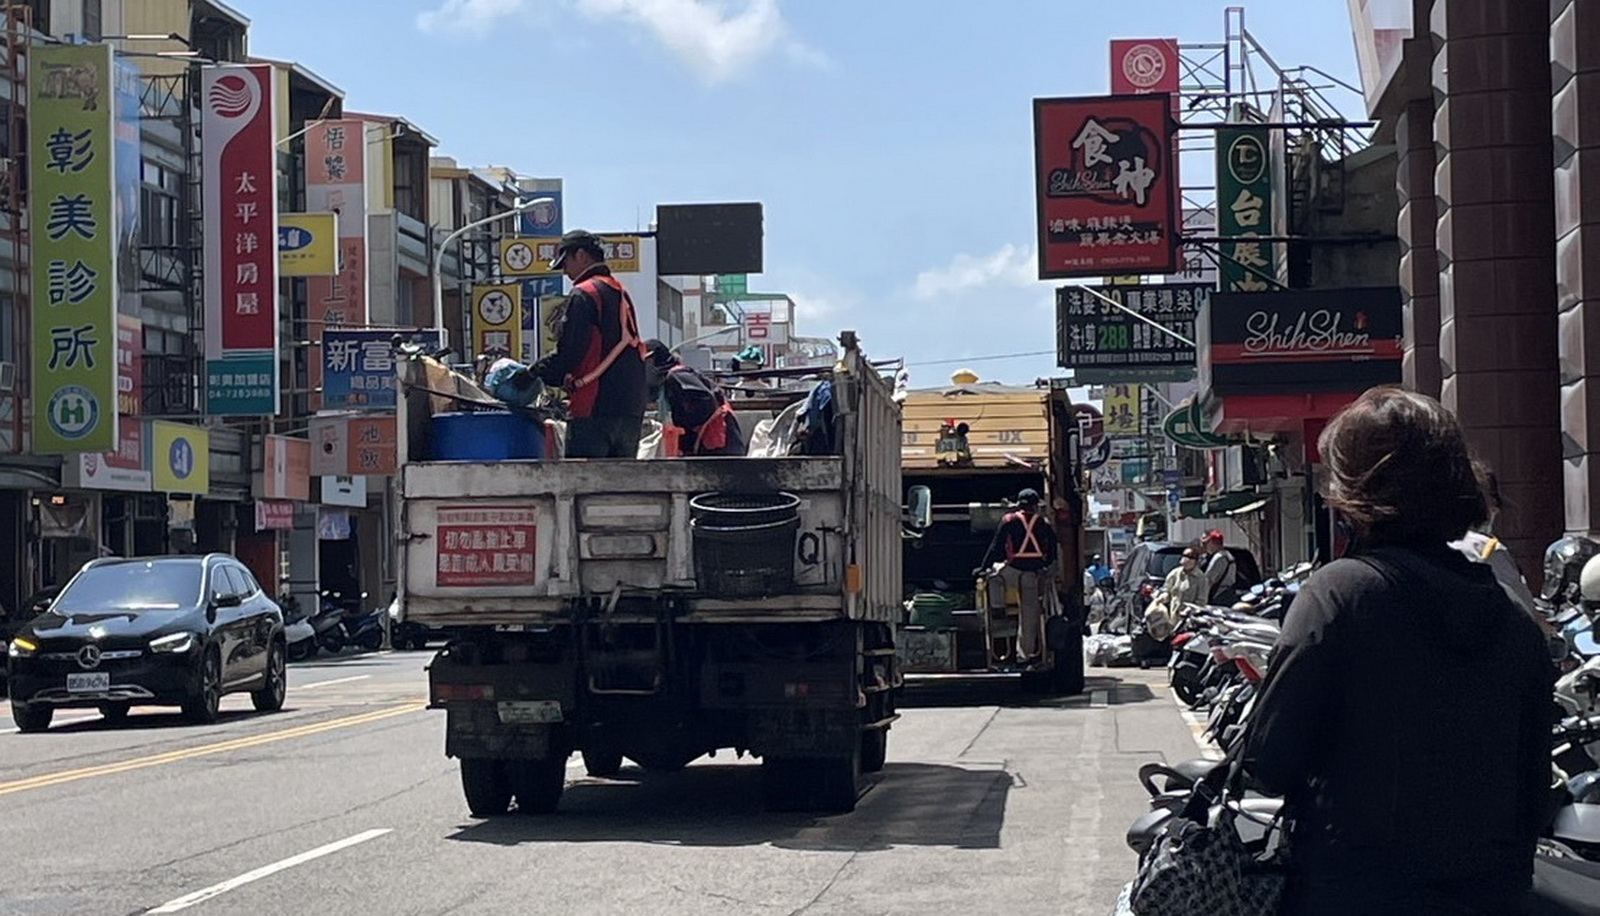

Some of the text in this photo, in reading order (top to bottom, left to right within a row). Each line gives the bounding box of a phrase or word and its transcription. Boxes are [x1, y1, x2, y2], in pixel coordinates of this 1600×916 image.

[1072, 119, 1155, 205] 食神
[46, 126, 97, 370] 彰美診所
[234, 171, 259, 315] 太平洋房屋
[1100, 325, 1128, 350] 288
[1244, 309, 1369, 352] ShihShen
